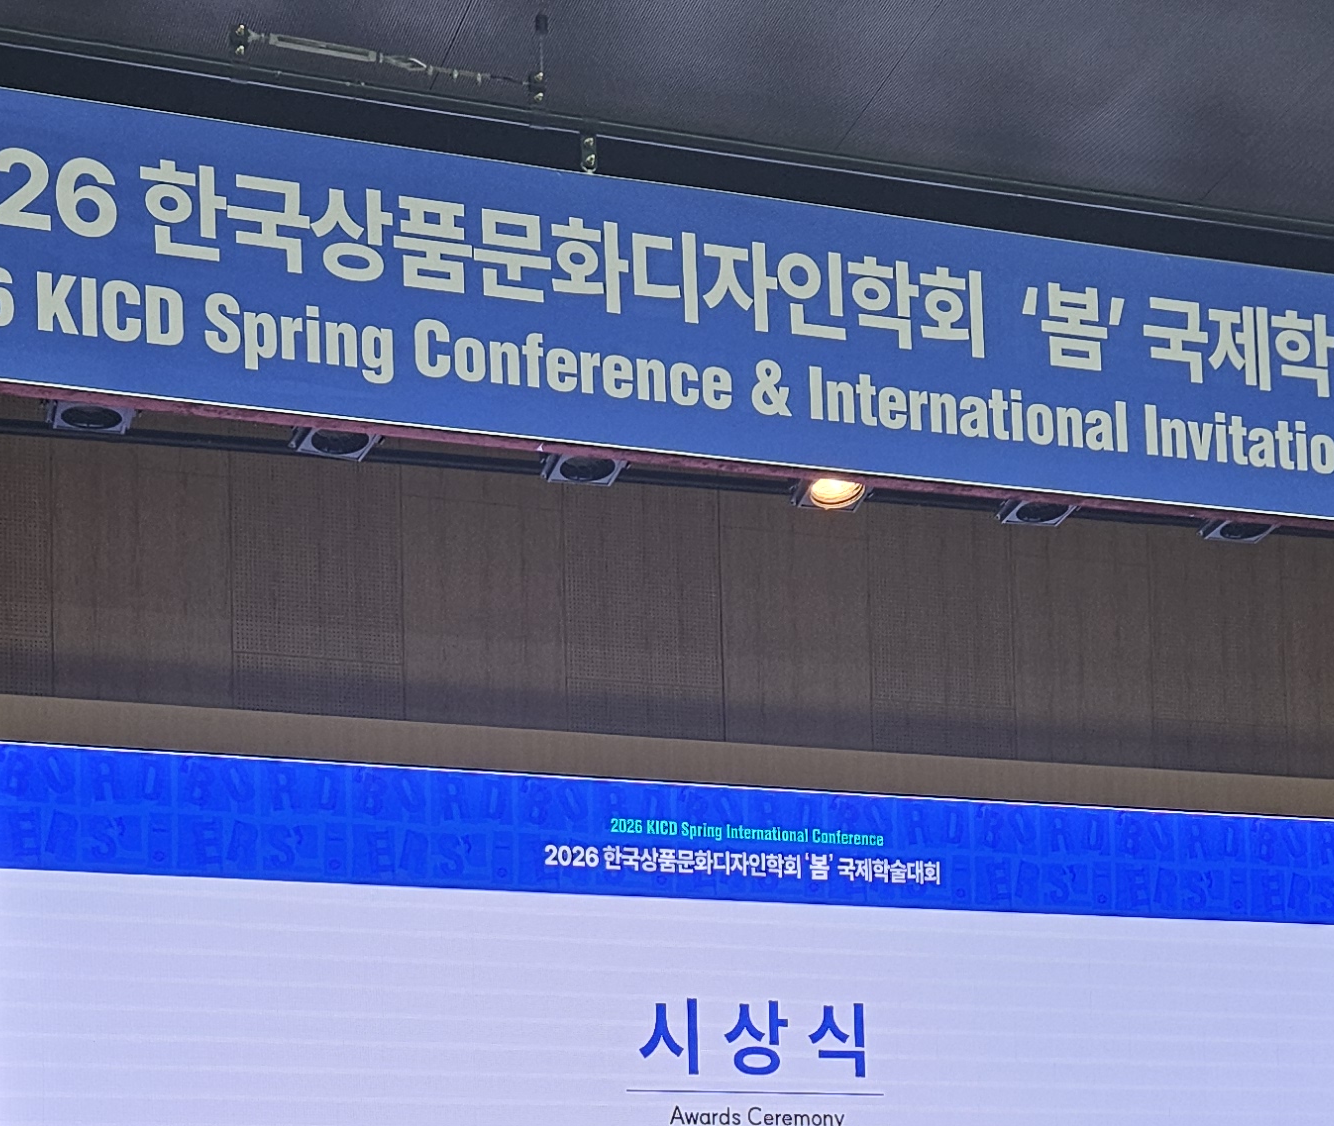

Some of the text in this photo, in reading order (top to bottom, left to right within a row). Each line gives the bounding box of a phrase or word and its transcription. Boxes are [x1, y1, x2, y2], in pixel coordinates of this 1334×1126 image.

[139, 158, 985, 360] 한국상품문화디자인학회
[36, 271, 185, 346] KICD
[204, 292, 394, 384] Spring
[414, 317, 733, 410] Conference
[751, 359, 793, 418] &
[809, 366, 1127, 453] International
[610, 817, 884, 846] 2026 KICD Spring International Conference
[544, 844, 599, 867] 2026
[602, 845, 802, 879] 한국상품문화디자인학회
[837, 857, 941, 885] 국제학술대회
[669, 1105, 742, 1126] Awards
